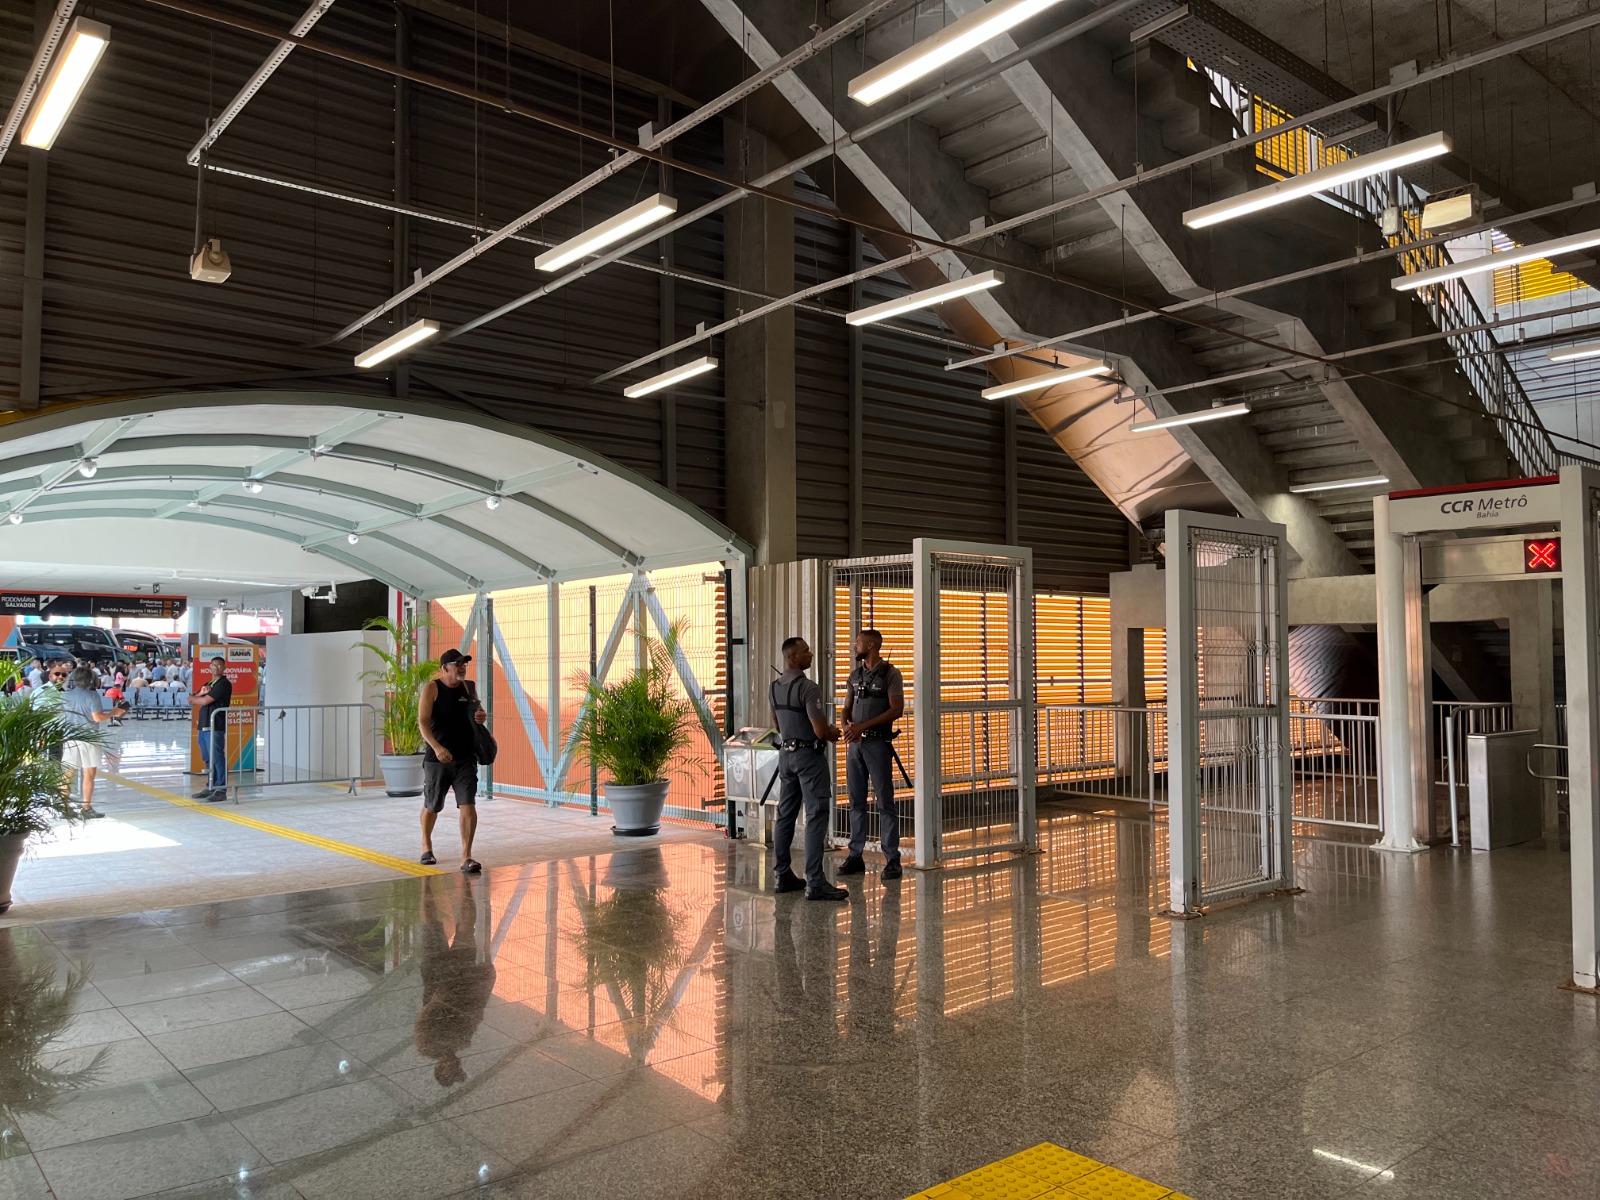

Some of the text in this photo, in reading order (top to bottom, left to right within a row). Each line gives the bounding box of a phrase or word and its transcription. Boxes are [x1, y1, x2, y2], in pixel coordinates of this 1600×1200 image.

[1440, 495, 1528, 514] CCR Metrô
[1476, 511, 1500, 519] Bahia
